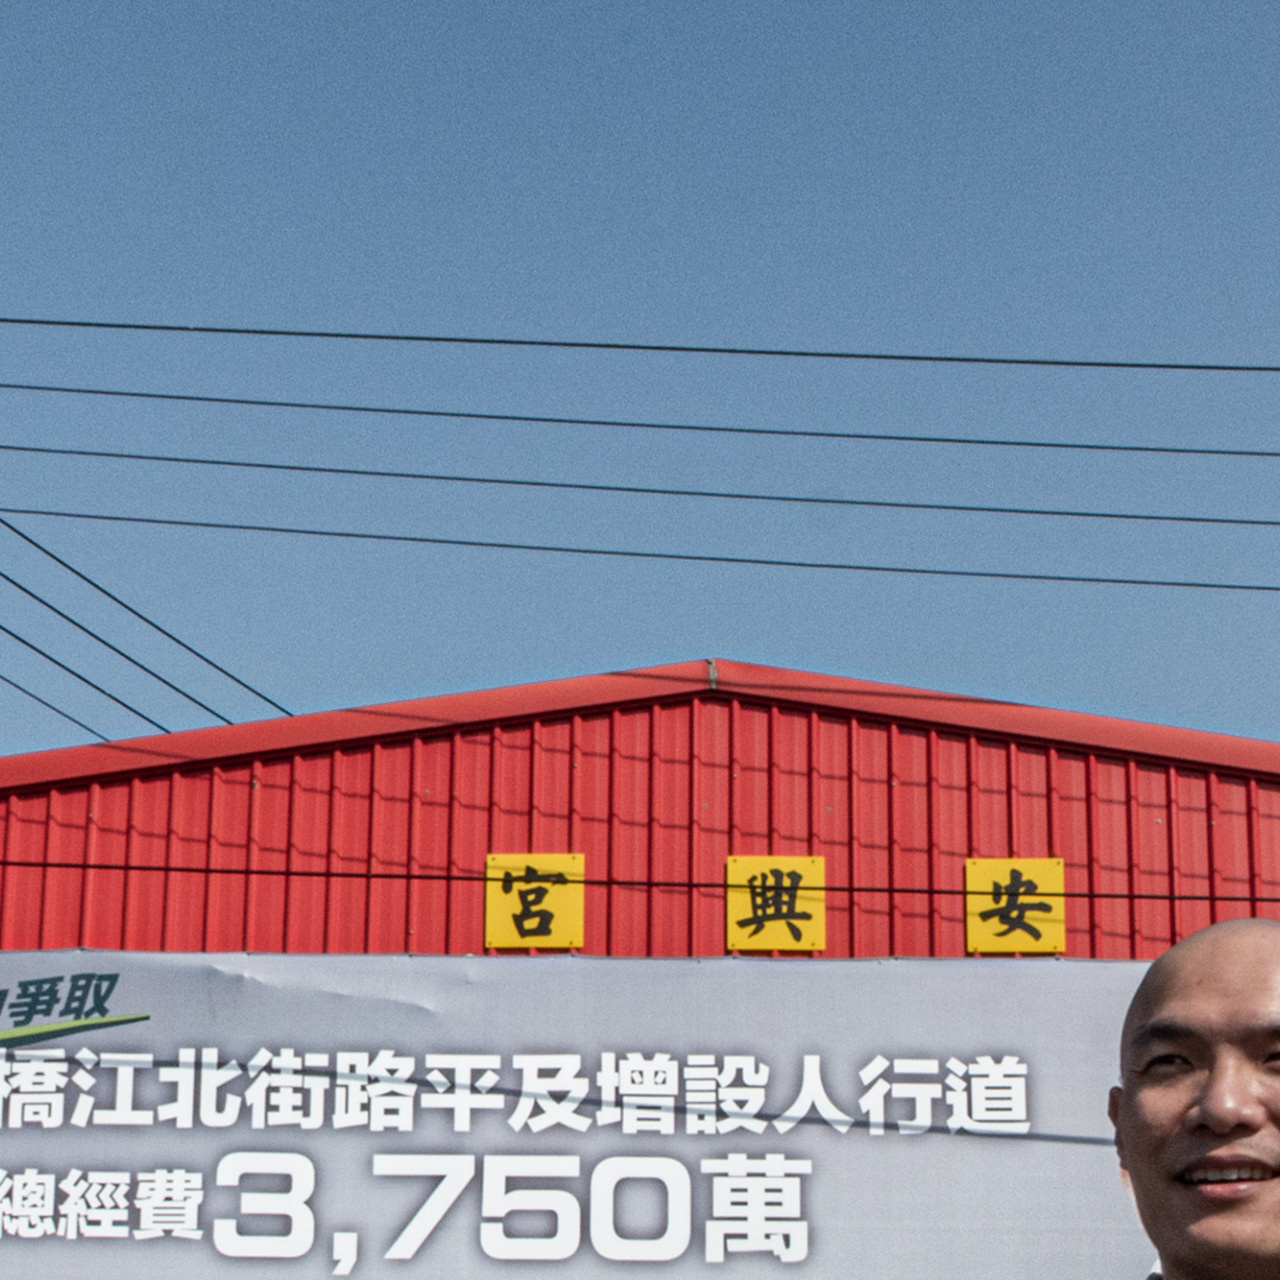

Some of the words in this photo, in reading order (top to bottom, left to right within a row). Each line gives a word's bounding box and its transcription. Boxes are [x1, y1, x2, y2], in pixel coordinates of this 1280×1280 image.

[502, 865, 569, 939] 宮
[737, 868, 813, 942] 興
[979, 868, 1053, 941] 安
